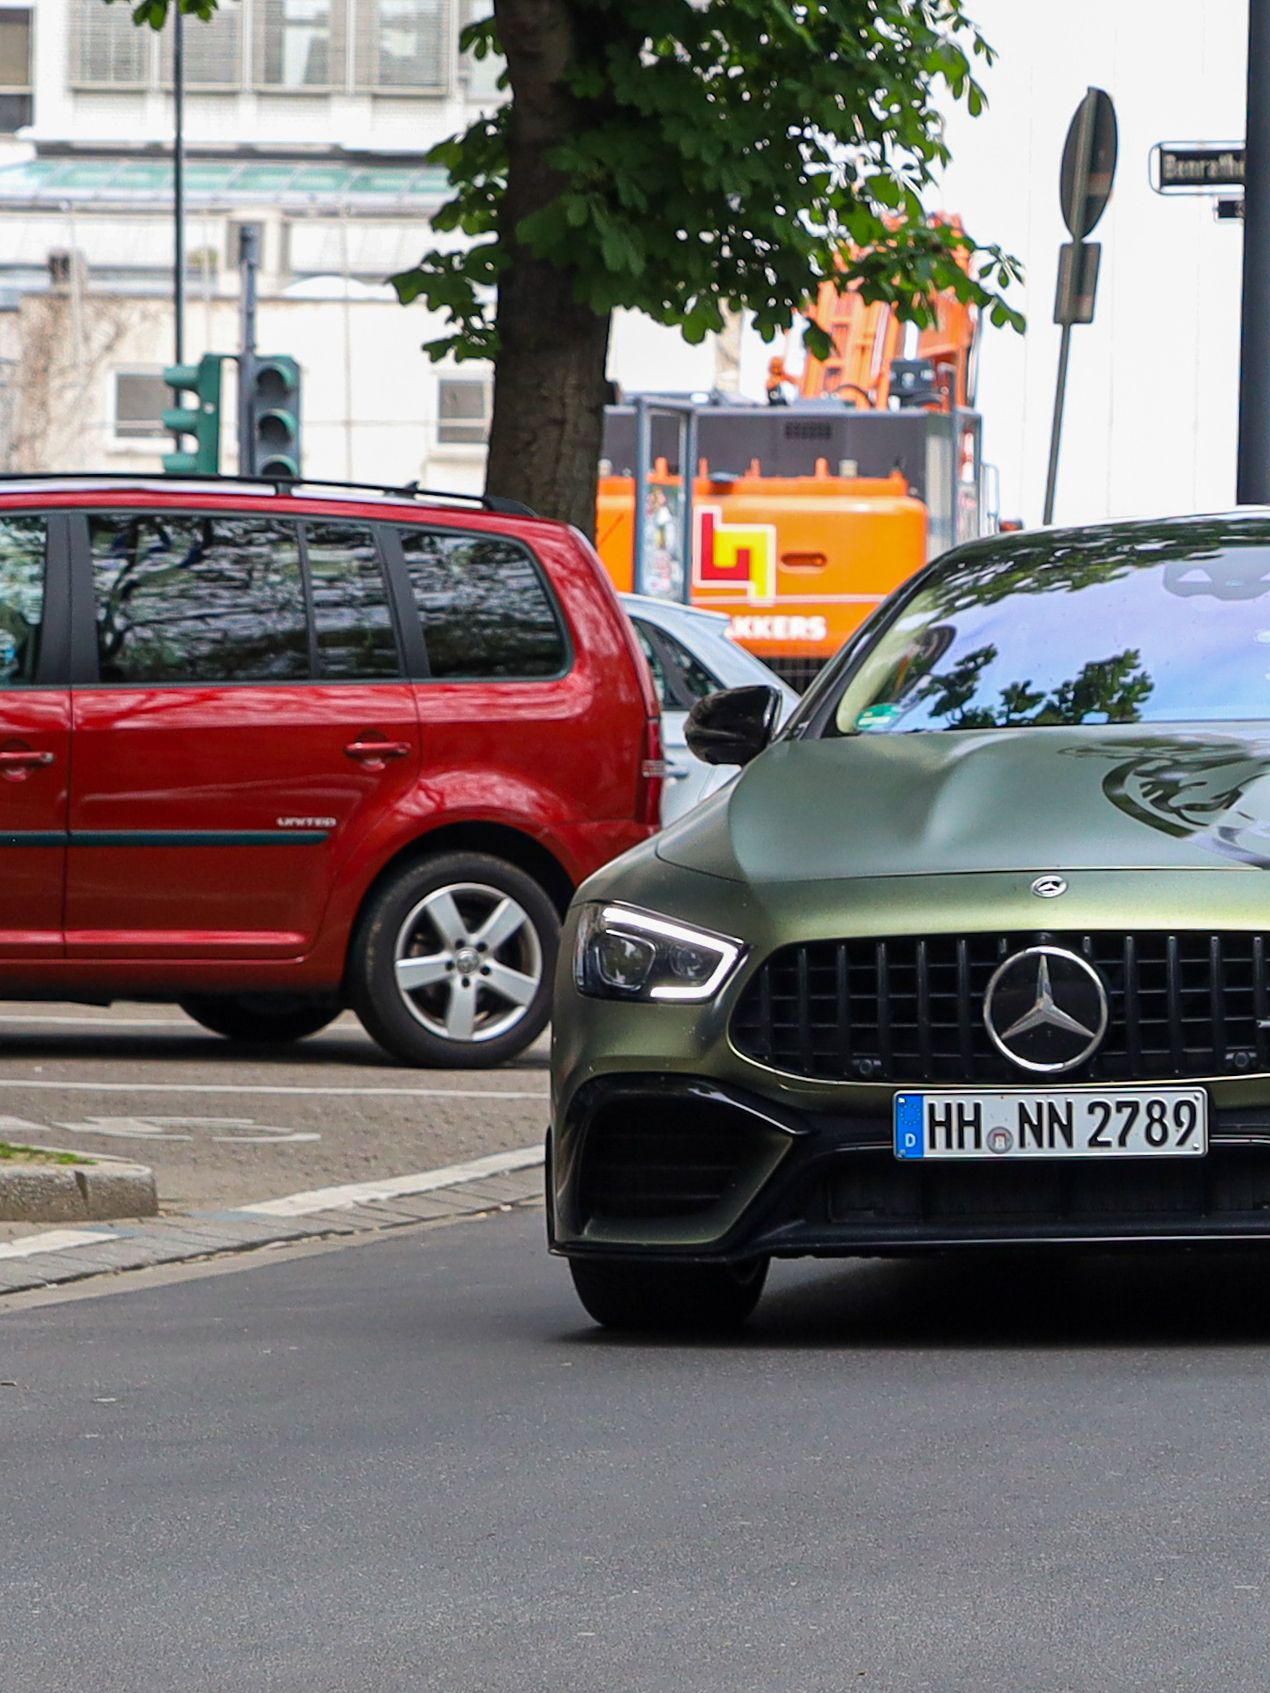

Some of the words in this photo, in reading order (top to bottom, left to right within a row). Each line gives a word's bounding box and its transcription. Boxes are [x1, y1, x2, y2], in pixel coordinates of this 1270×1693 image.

[905, 1132, 916, 1147] D
[928, 1101, 982, 1150] HH
[1018, 1100, 1073, 1149] NN
[1087, 1099, 1198, 1148] 2789
